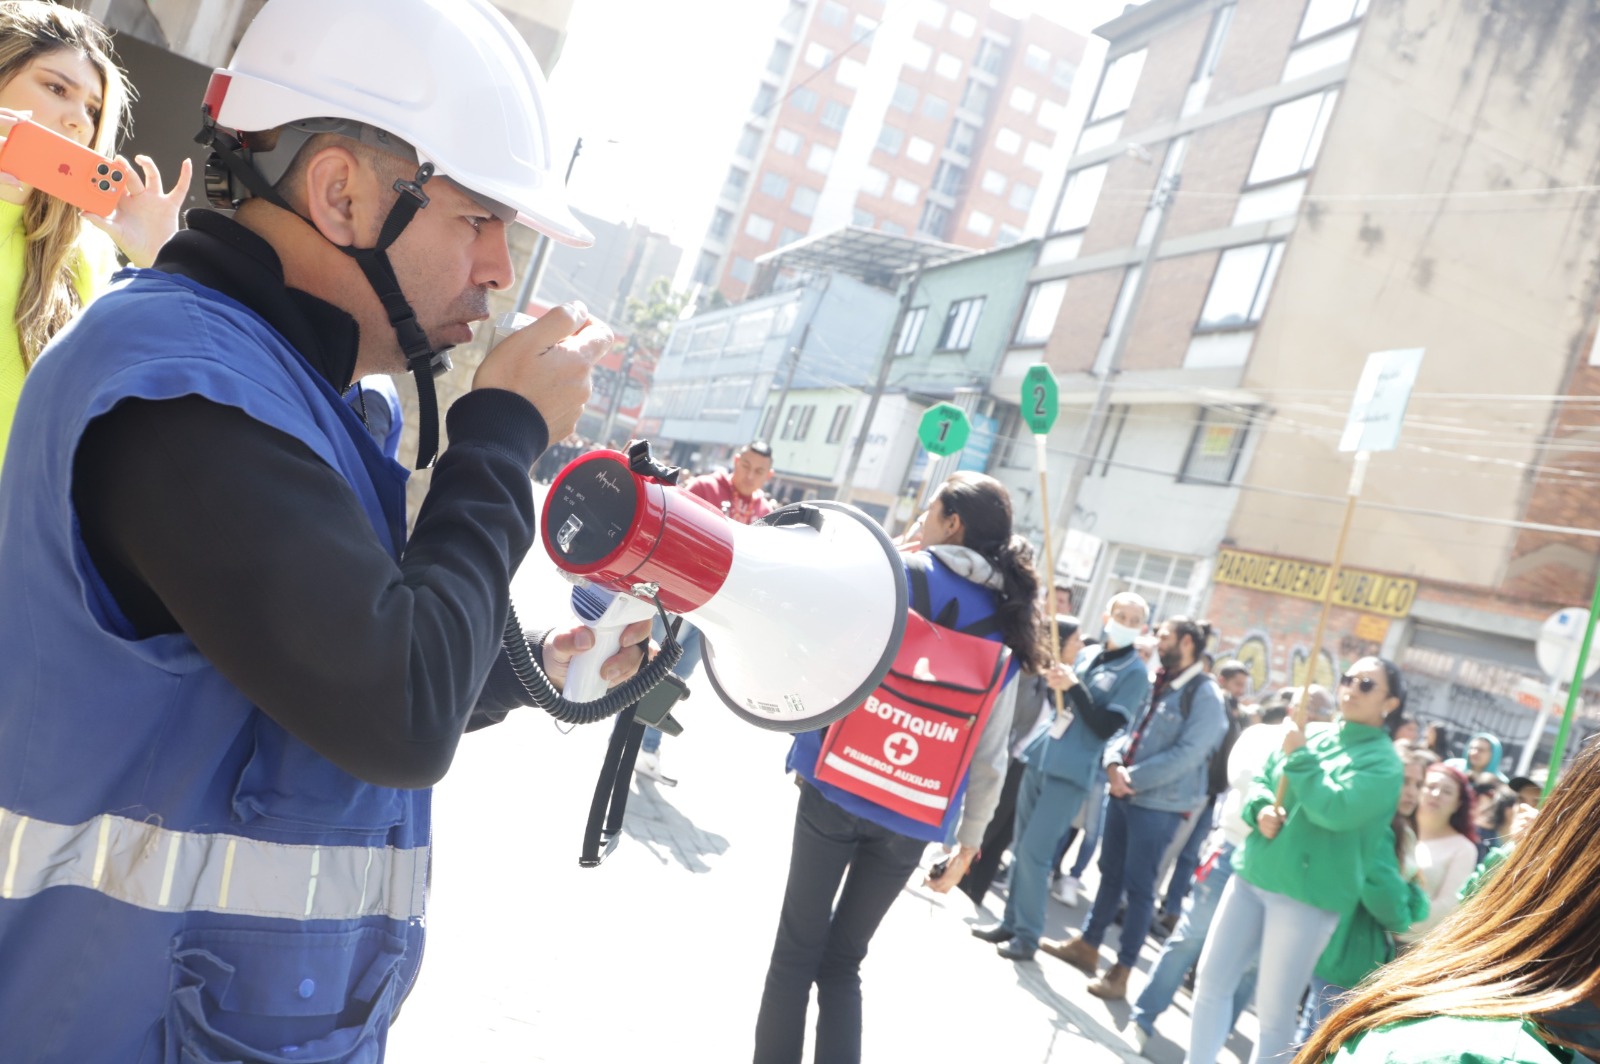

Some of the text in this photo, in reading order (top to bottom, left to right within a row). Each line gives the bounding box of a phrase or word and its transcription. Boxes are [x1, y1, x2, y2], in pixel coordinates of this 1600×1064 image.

[1033, 386, 1046, 416] 2
[939, 422, 949, 441] 1
[1218, 553, 1412, 613] PARQUEADERO PUBLICO
[864, 695, 959, 743] BOTIQUÍN
[842, 746, 941, 790] PRIMEROS AUXILIOS
